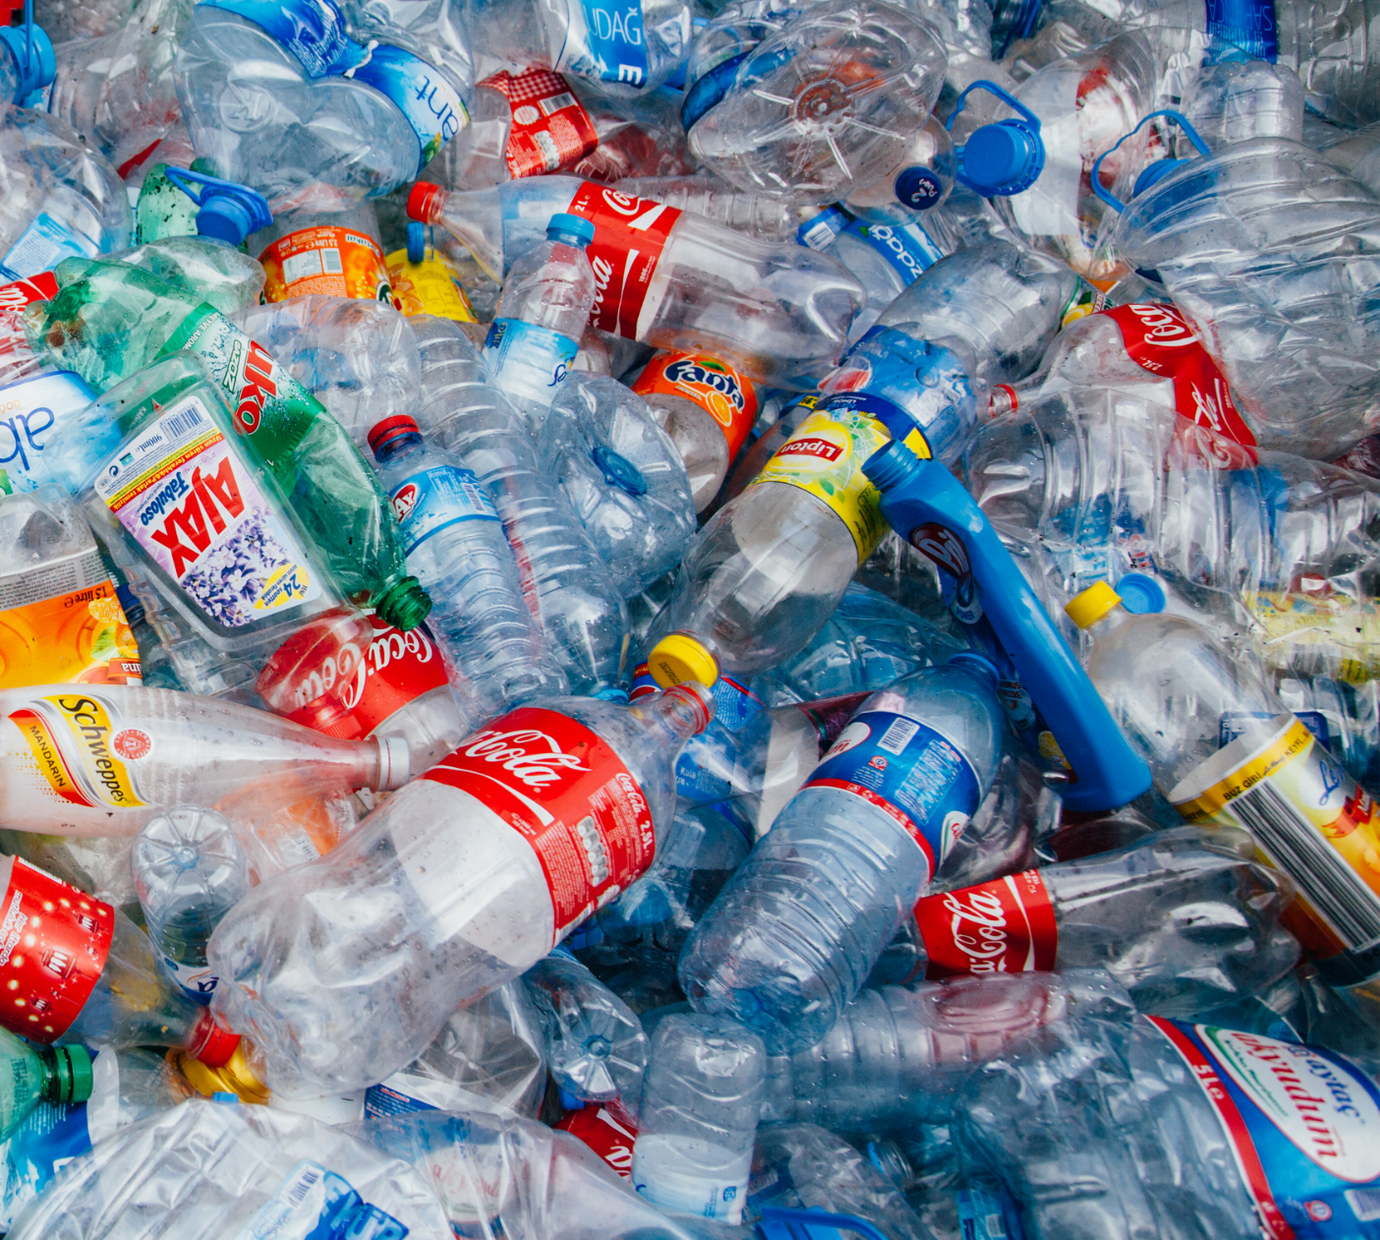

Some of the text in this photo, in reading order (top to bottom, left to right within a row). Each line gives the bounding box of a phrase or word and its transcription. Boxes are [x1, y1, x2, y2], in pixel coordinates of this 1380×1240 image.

[415, 74, 460, 142] ant
[198, 310, 221, 332] MEYVE
[1127, 304, 1200, 348] Coca
[222, 339, 243, 396] GAZOZ
[233, 339, 278, 436] uko
[662, 359, 746, 413] Fanta
[138, 432, 162, 452] 900ml
[184, 444, 205, 460] süren
[203, 434, 221, 448] Uzun
[780, 440, 838, 462] Lipton
[112, 489, 137, 510] temizlik
[140, 468, 191, 526] Fabuloso
[151, 456, 246, 579] AJAX
[925, 535, 971, 576] Pril
[73, 589, 95, 605] litre
[281, 575, 302, 595] 24
[29, 724, 66, 789] MANDARIN
[58, 696, 128, 805] Schweppes
[615, 772, 648, 817] Coca-Cola
[1224, 770, 1261, 800] BUZ GİBİ
[1229, 1032, 1338, 1161] akyudum
[1303, 1049, 1362, 1121] aytaç
